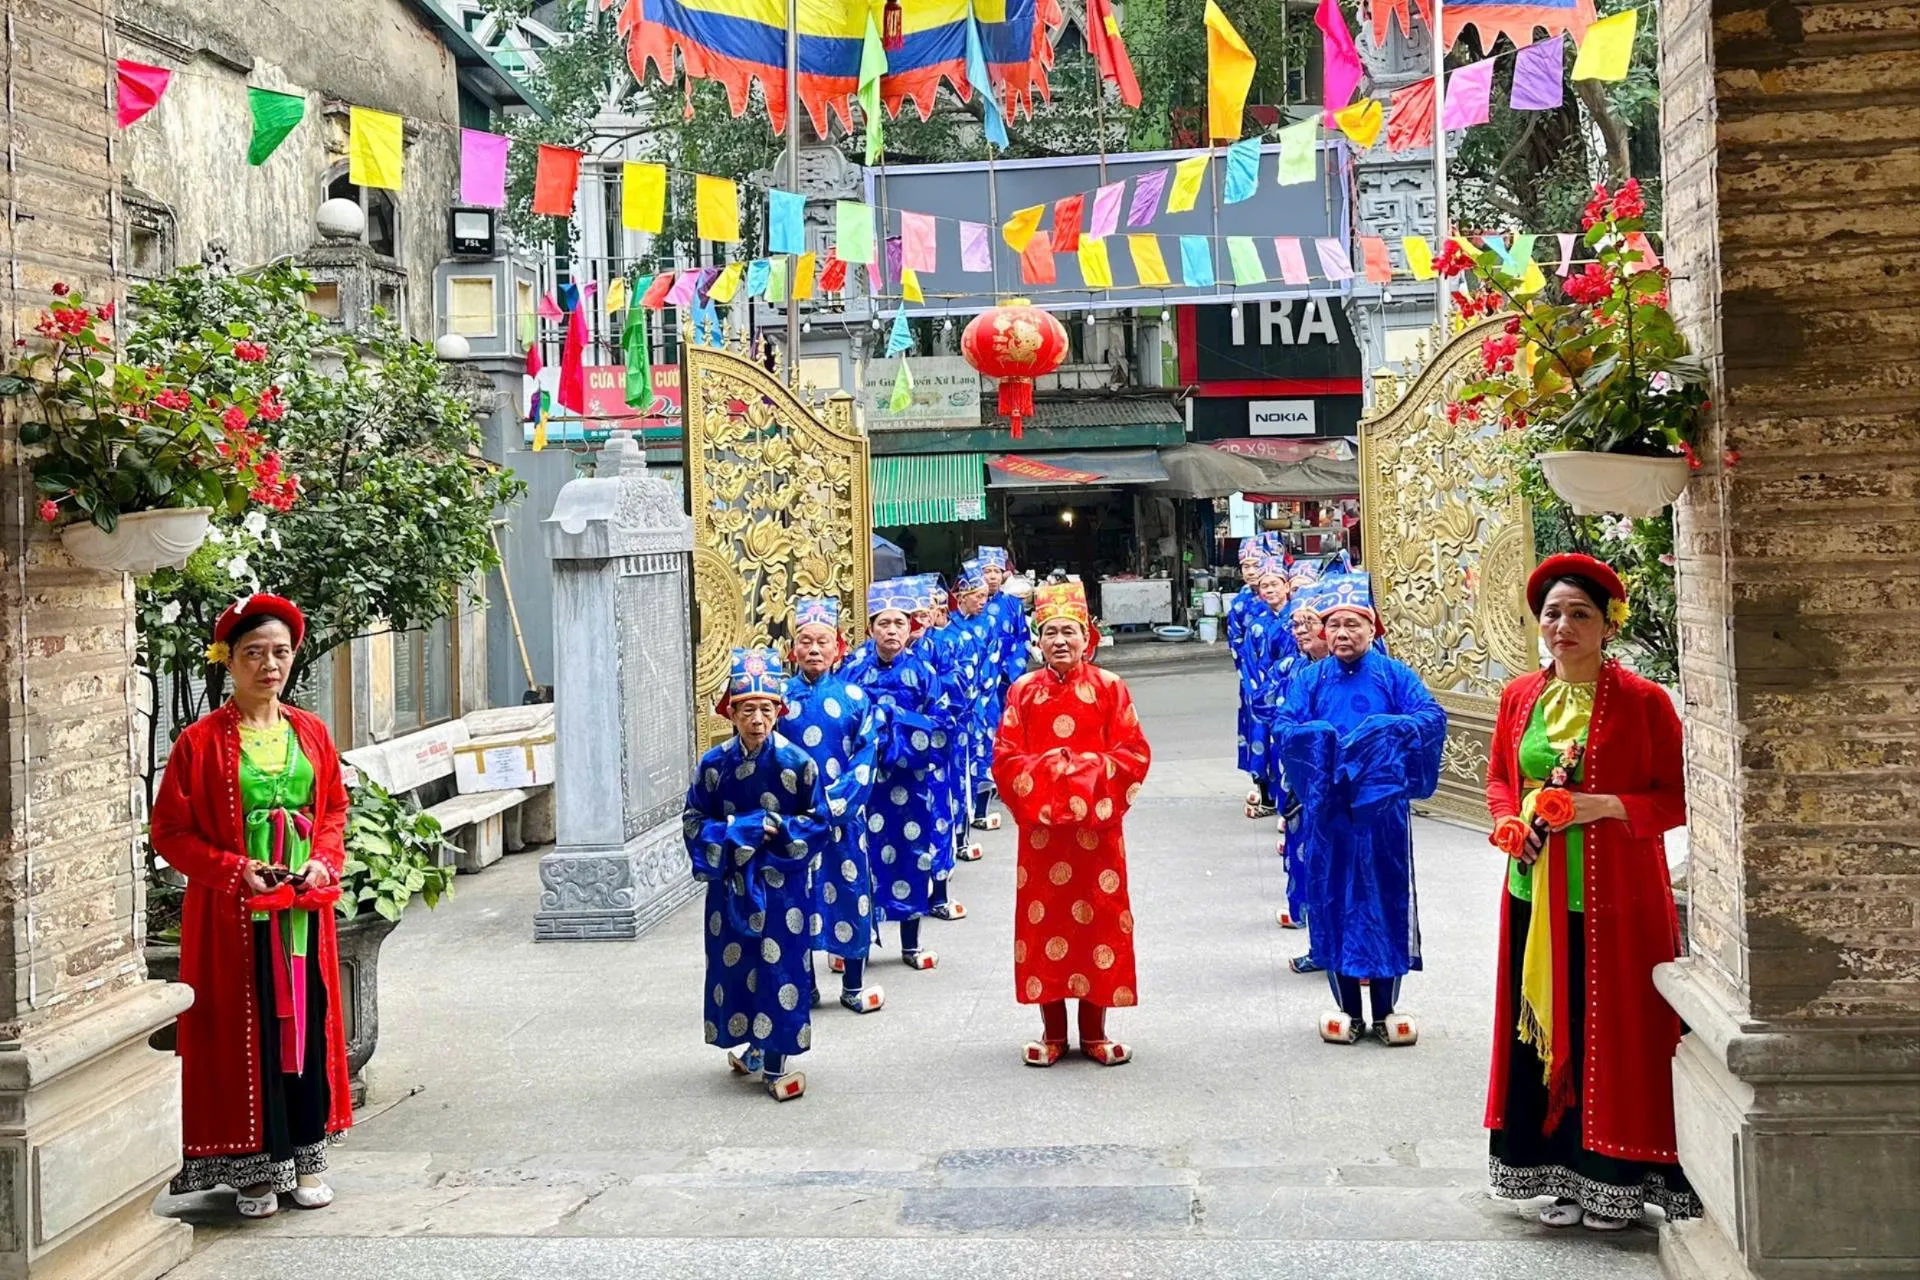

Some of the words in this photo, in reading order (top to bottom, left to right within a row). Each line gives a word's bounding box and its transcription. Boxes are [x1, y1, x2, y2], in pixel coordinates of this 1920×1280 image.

[1232, 297, 1347, 346] TRA
[590, 368, 614, 388] CỬA
[656, 368, 681, 388] CƯỚ
[1256, 412, 1308, 423] NOKIA
